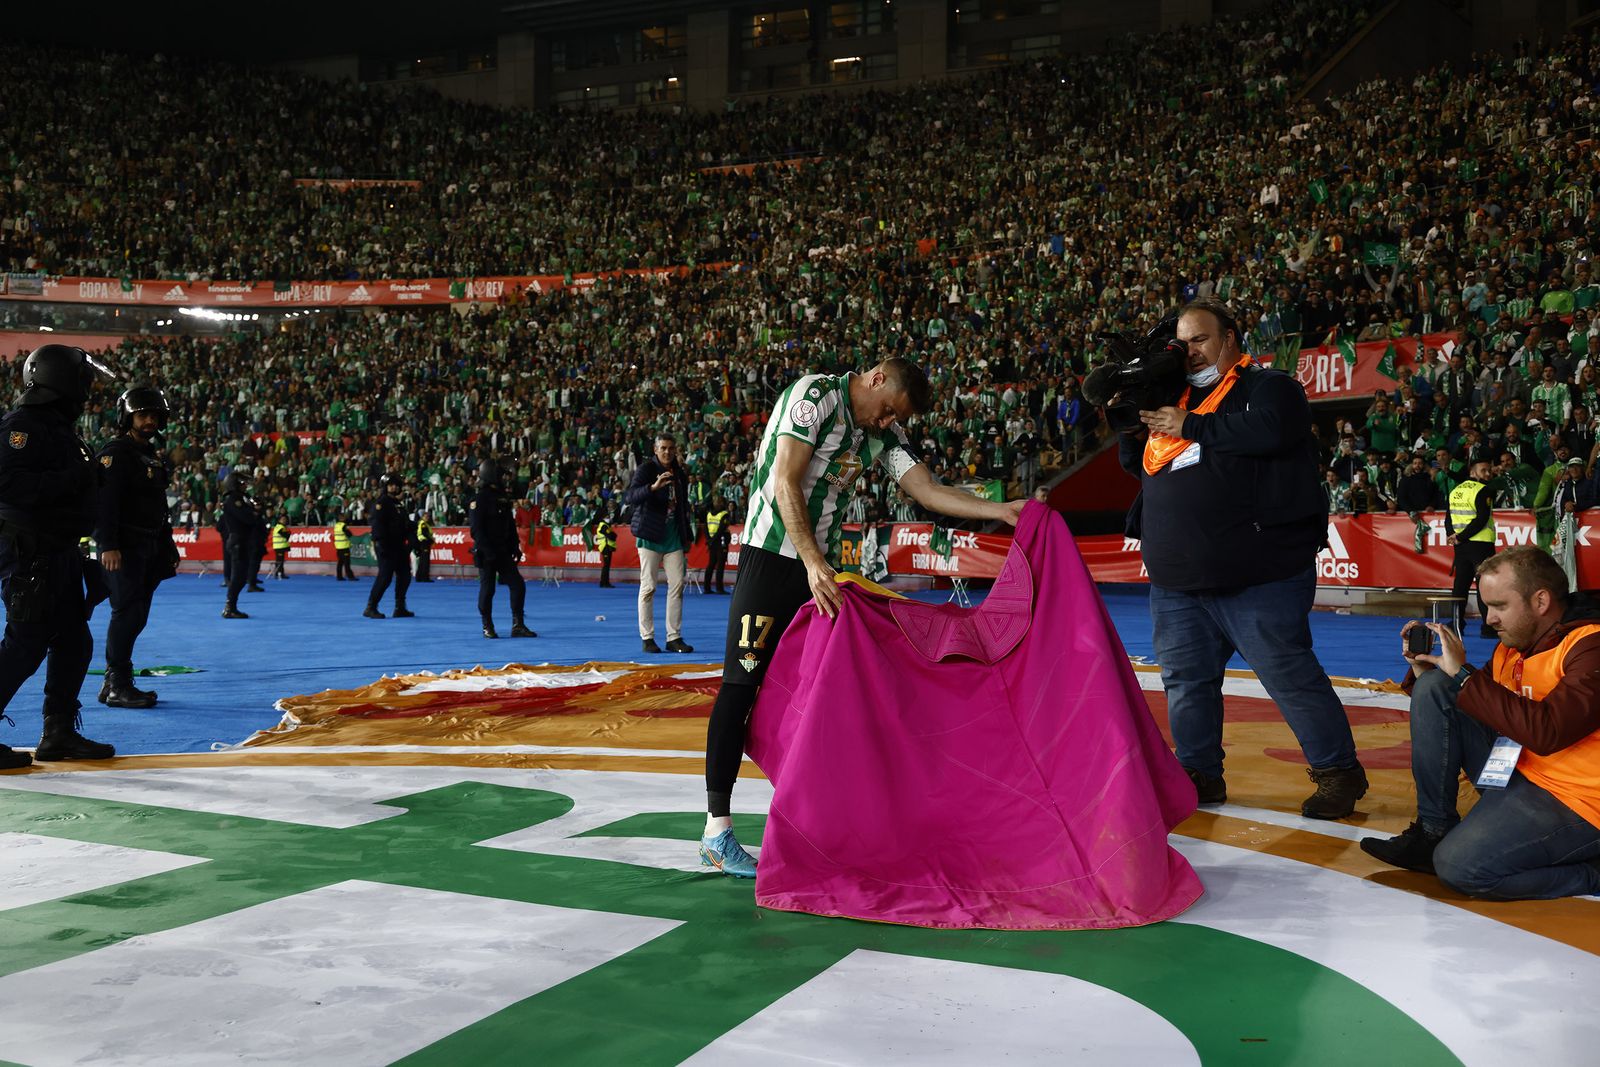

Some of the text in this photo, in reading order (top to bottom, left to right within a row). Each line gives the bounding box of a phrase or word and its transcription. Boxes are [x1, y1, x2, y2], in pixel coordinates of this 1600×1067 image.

[80, 281, 109, 298] COPA
[313, 284, 332, 302] REY
[486, 281, 504, 298] REY
[1315, 353, 1354, 393] REY
[172, 531, 197, 543] work
[897, 528, 979, 549] fineork
[738, 614, 774, 649] 17
